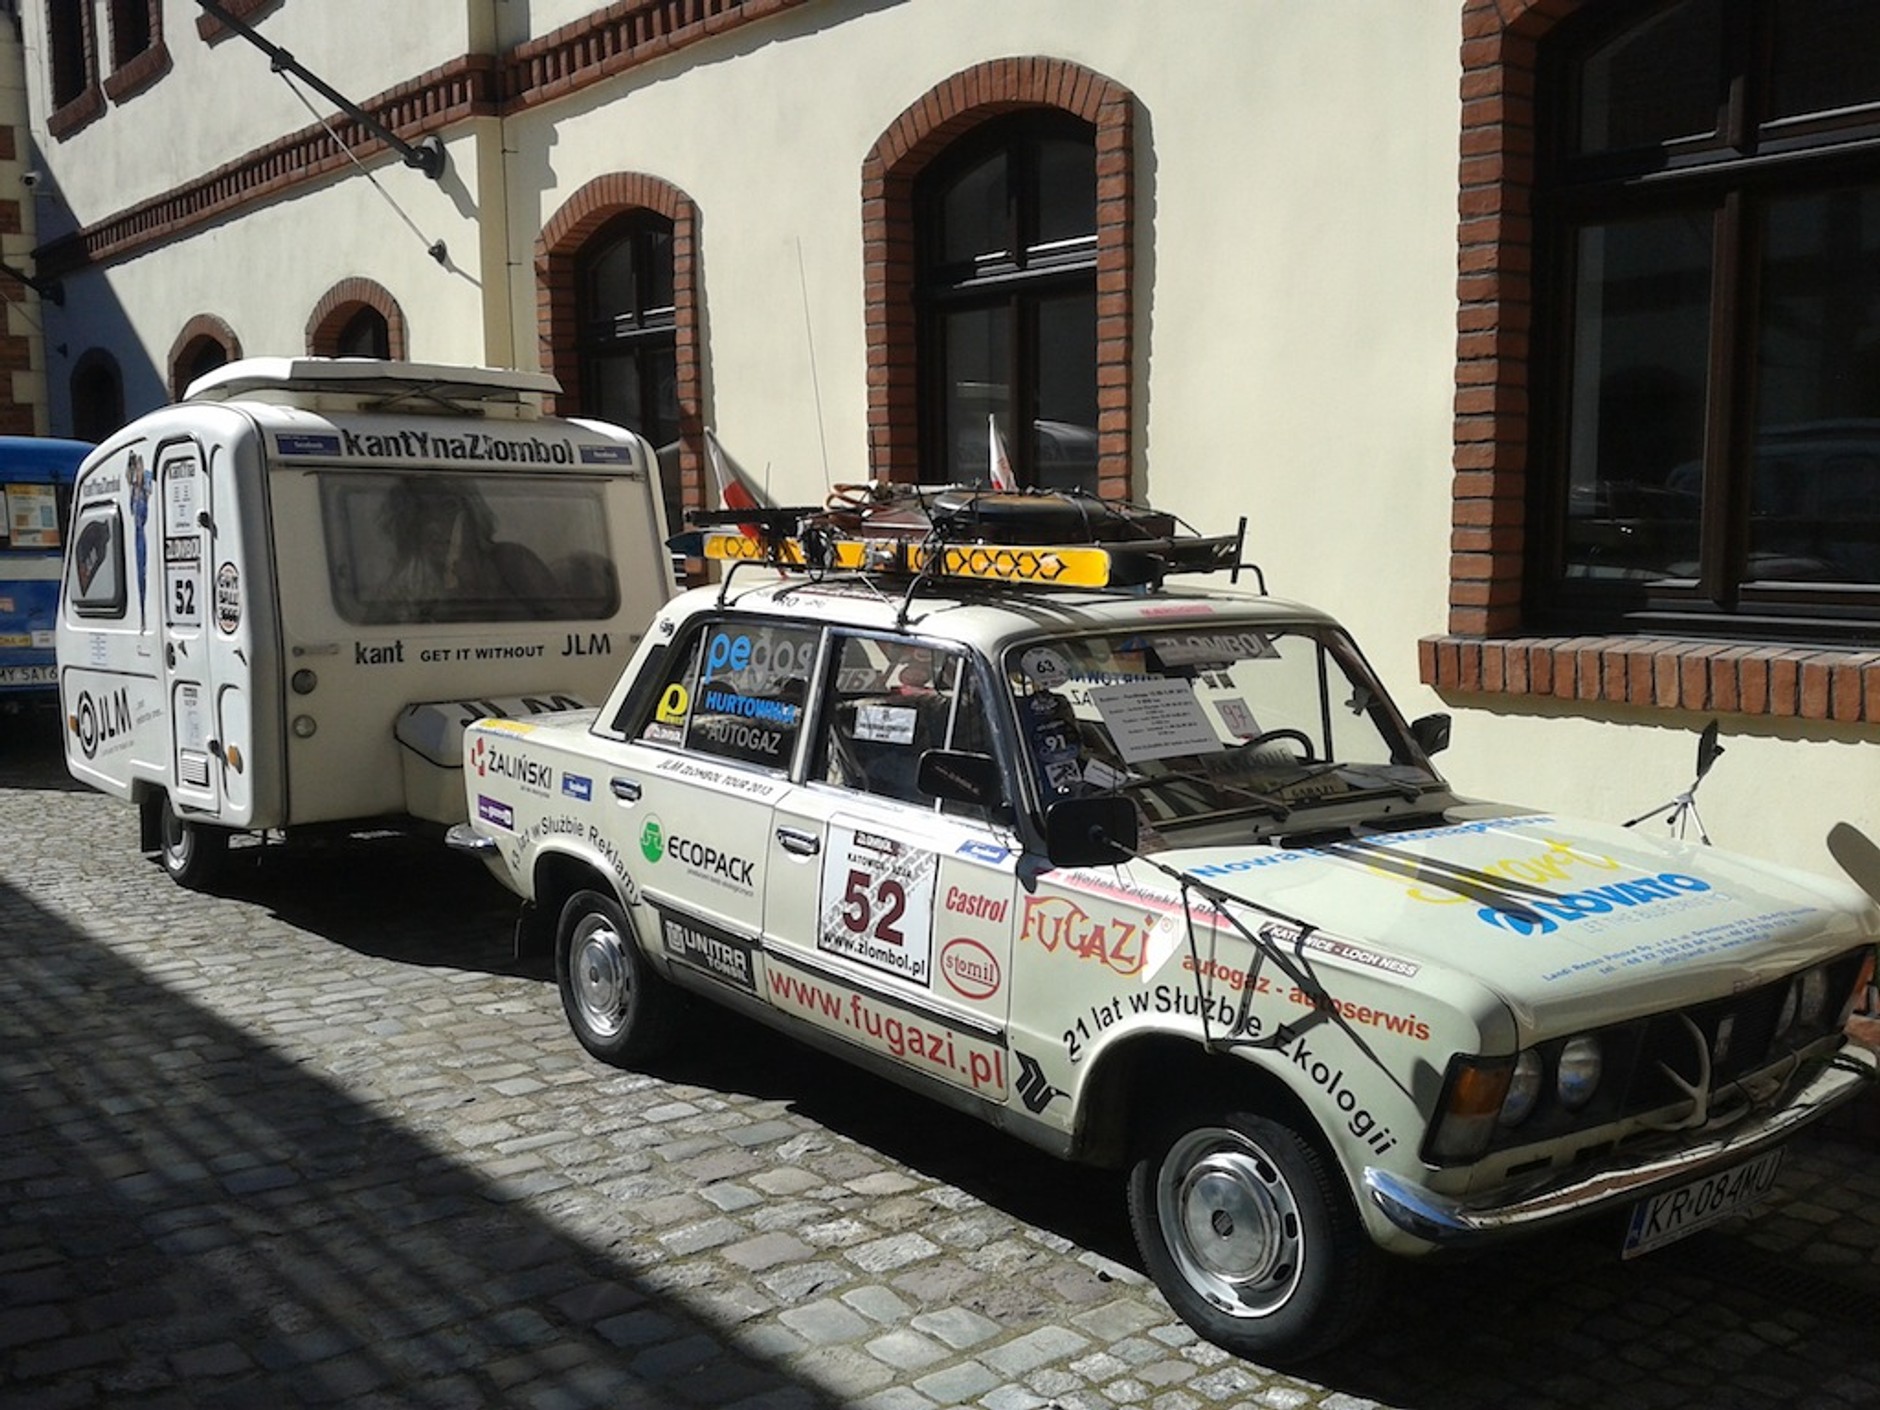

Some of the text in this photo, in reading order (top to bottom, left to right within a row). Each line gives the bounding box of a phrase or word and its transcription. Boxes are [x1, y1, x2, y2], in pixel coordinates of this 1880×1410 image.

[175, 579, 195, 615] 52
[355, 640, 545, 665] kant GET IT WITHOUT
[561, 633, 611, 657] JLM
[99, 687, 133, 742] JLM
[707, 717, 782, 754] AUTOGAZ
[1044, 734, 1066, 752] 91
[488, 745, 552, 790] ŻALIŃSKI
[588, 825, 641, 906] Reklamy
[667, 835, 754, 887] ECOPACK
[1190, 847, 1304, 878] Nowa
[841, 869, 906, 947] 52
[946, 886, 1009, 923] Castrol
[1530, 873, 1711, 921] LOVATO
[684, 927, 748, 974] UNITRA
[946, 954, 995, 983] stomil
[1341, 947, 1379, 966] LOCH
[1378, 956, 1419, 977] NESS
[1182, 954, 1271, 995] autogaz
[767, 968, 1005, 1090] www.fugazi.pl
[1063, 1017, 1091, 1055] 21
[1092, 995, 1124, 1031] lat
[1128, 990, 1149, 1014] w
[1645, 1187, 1692, 1237] KR
